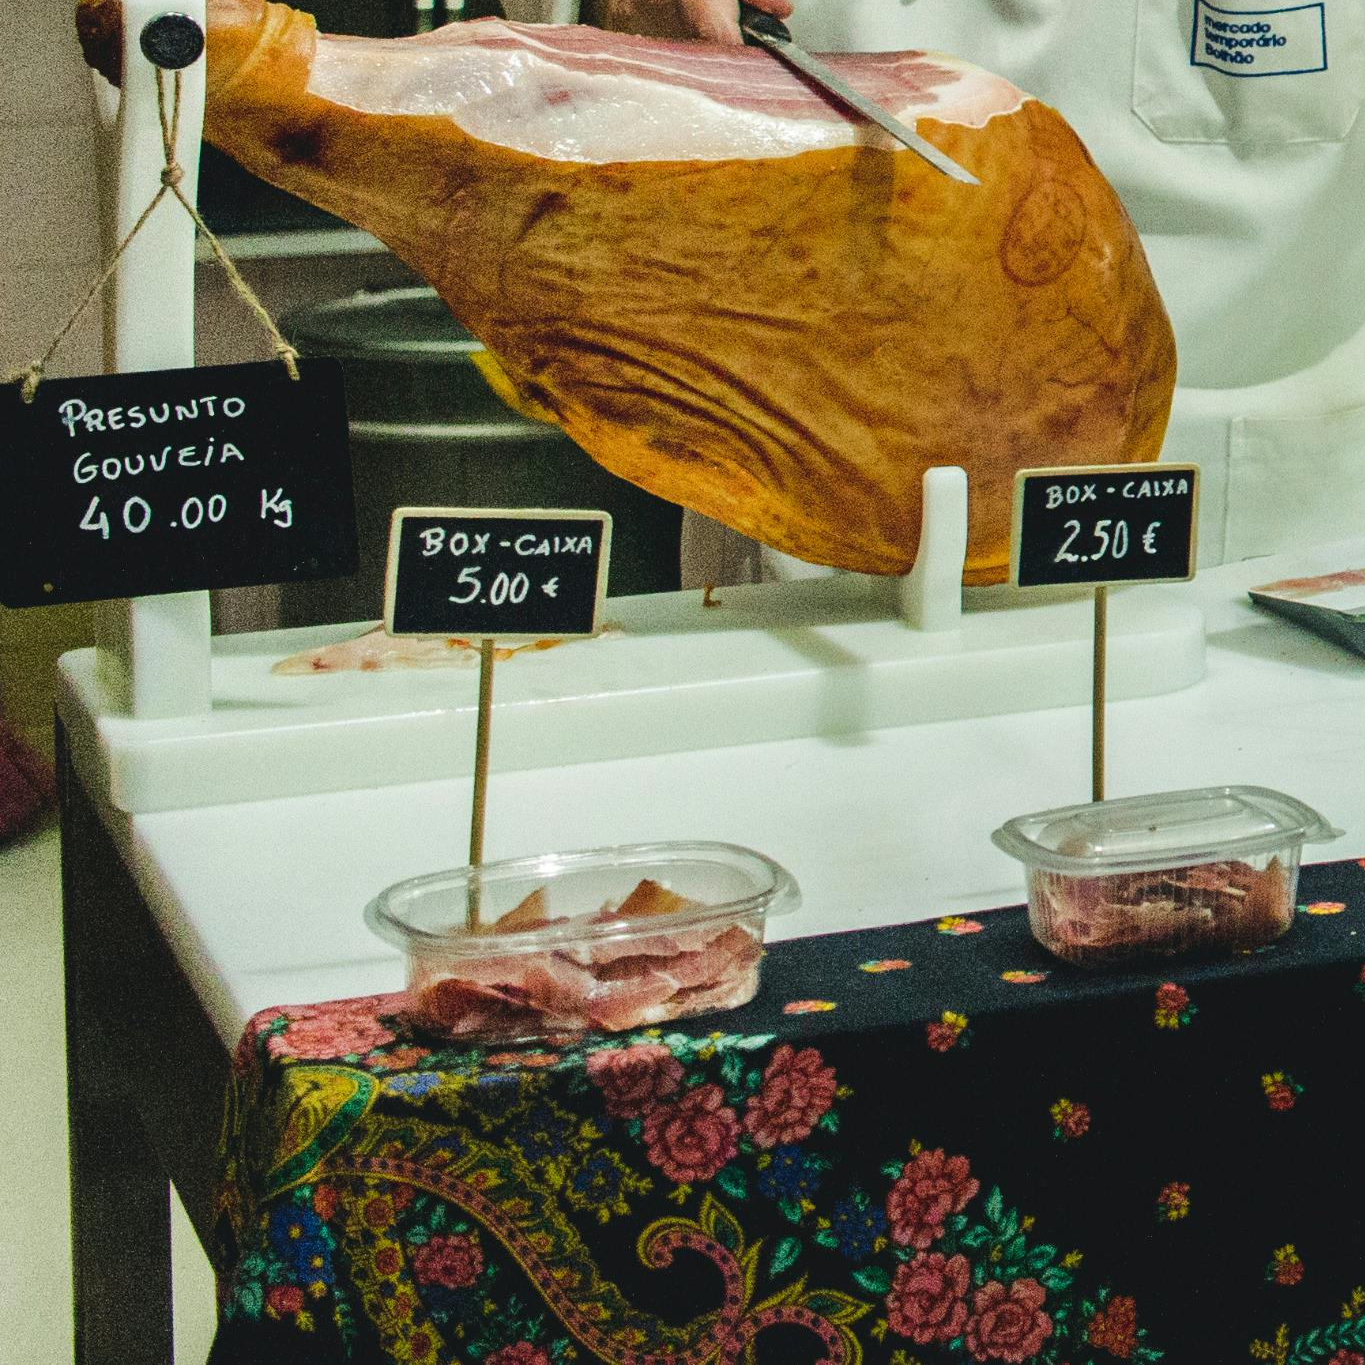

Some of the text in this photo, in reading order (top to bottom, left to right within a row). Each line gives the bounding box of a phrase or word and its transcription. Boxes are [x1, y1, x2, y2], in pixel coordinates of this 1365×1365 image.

[1204, 15, 1271, 34] mercado
[1204, 27, 1287, 50] temporário
[1205, 42, 1254, 64] Bolhão
[58, 396, 246, 437] PRESUNTO
[260, 488, 293, 528] Kg
[1054, 519, 1162, 563] 2.50 €
[448, 566, 559, 606] 5.00 €
